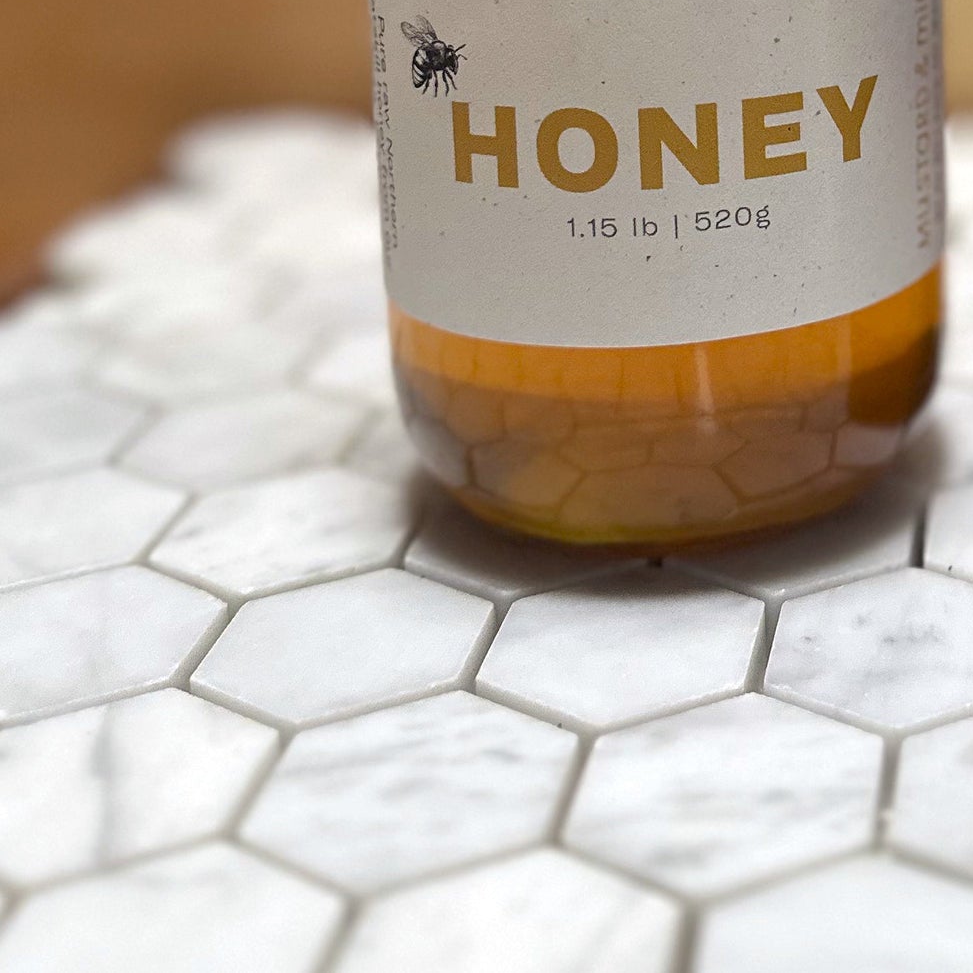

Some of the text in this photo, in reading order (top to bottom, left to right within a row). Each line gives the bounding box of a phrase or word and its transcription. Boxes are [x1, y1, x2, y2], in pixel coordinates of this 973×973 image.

[377, 15, 399, 248] Pure raw Northern
[451, 74, 879, 194] HONEY
[567, 217, 618, 239] 1.15
[632, 216, 659, 238] lb
[694, 204, 772, 233] 520g
